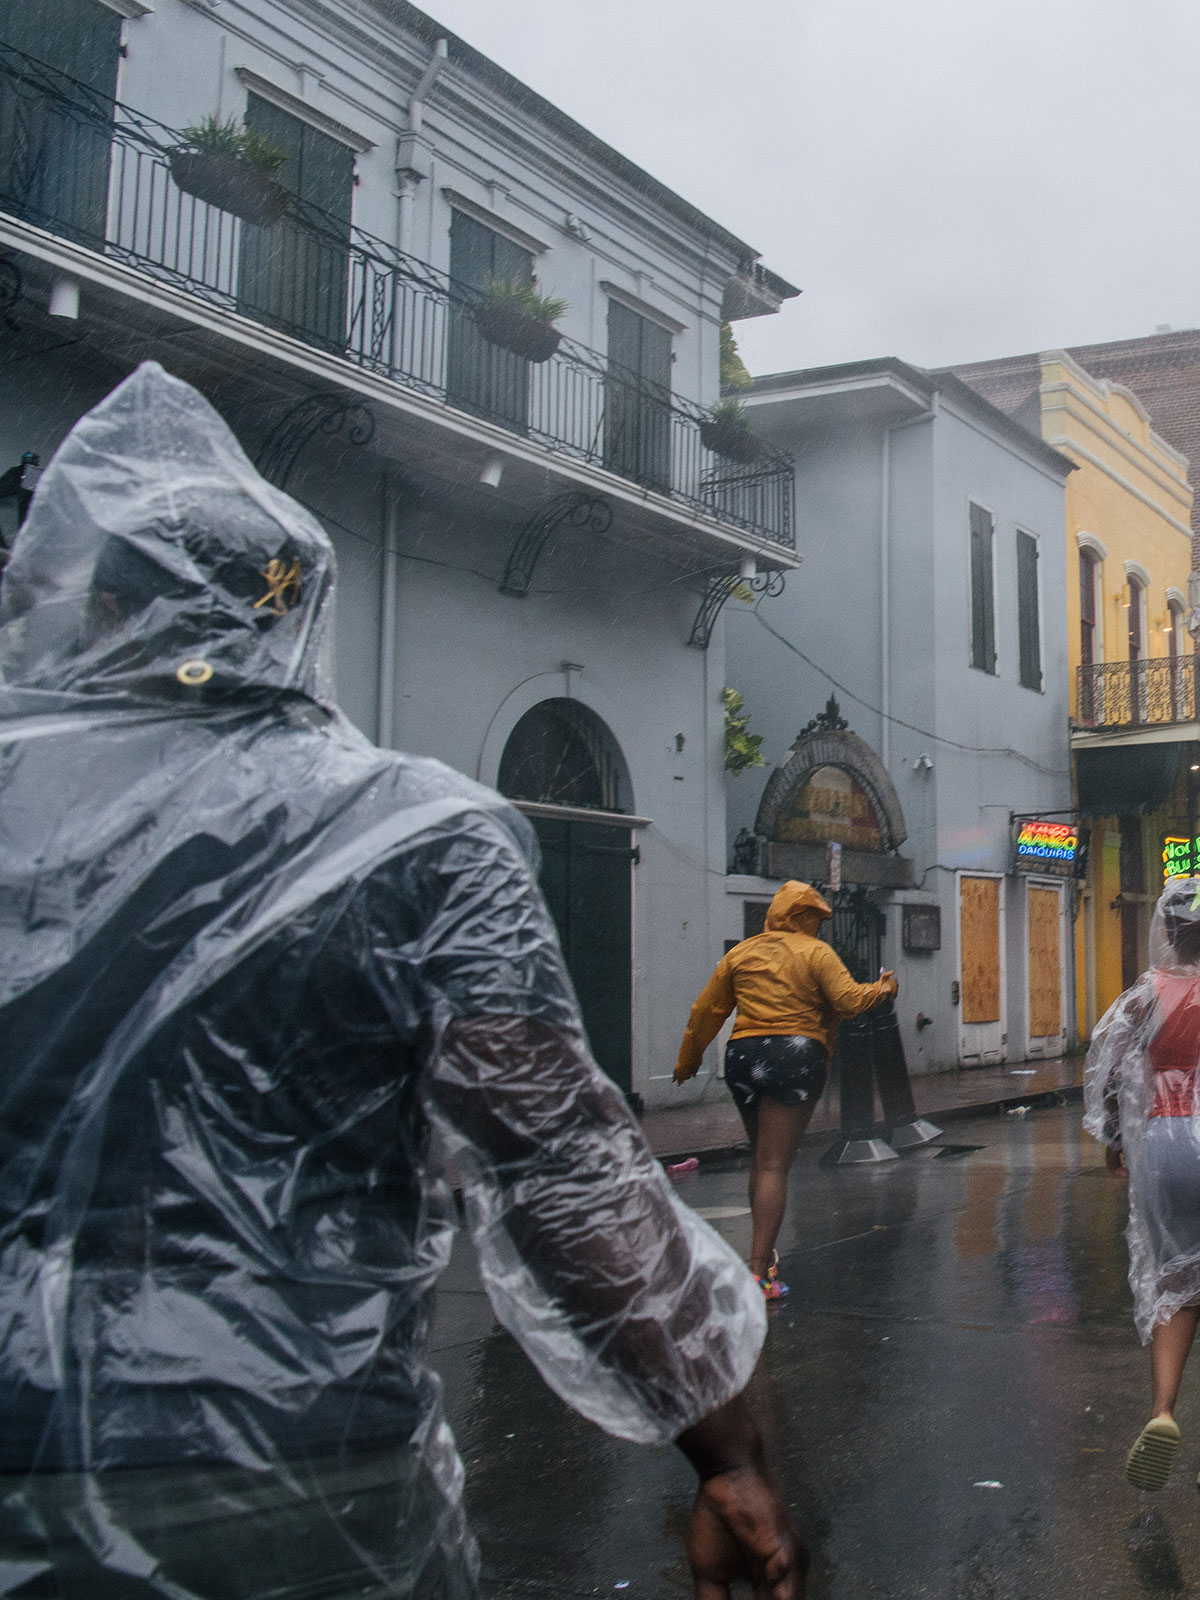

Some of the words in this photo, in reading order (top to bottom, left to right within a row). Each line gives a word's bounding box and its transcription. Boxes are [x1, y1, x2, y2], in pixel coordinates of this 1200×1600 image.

[1024, 823, 1071, 836] MANGO
[1017, 831, 1078, 851] MANGO
[1018, 844, 1075, 860] DAIQUIRIS
